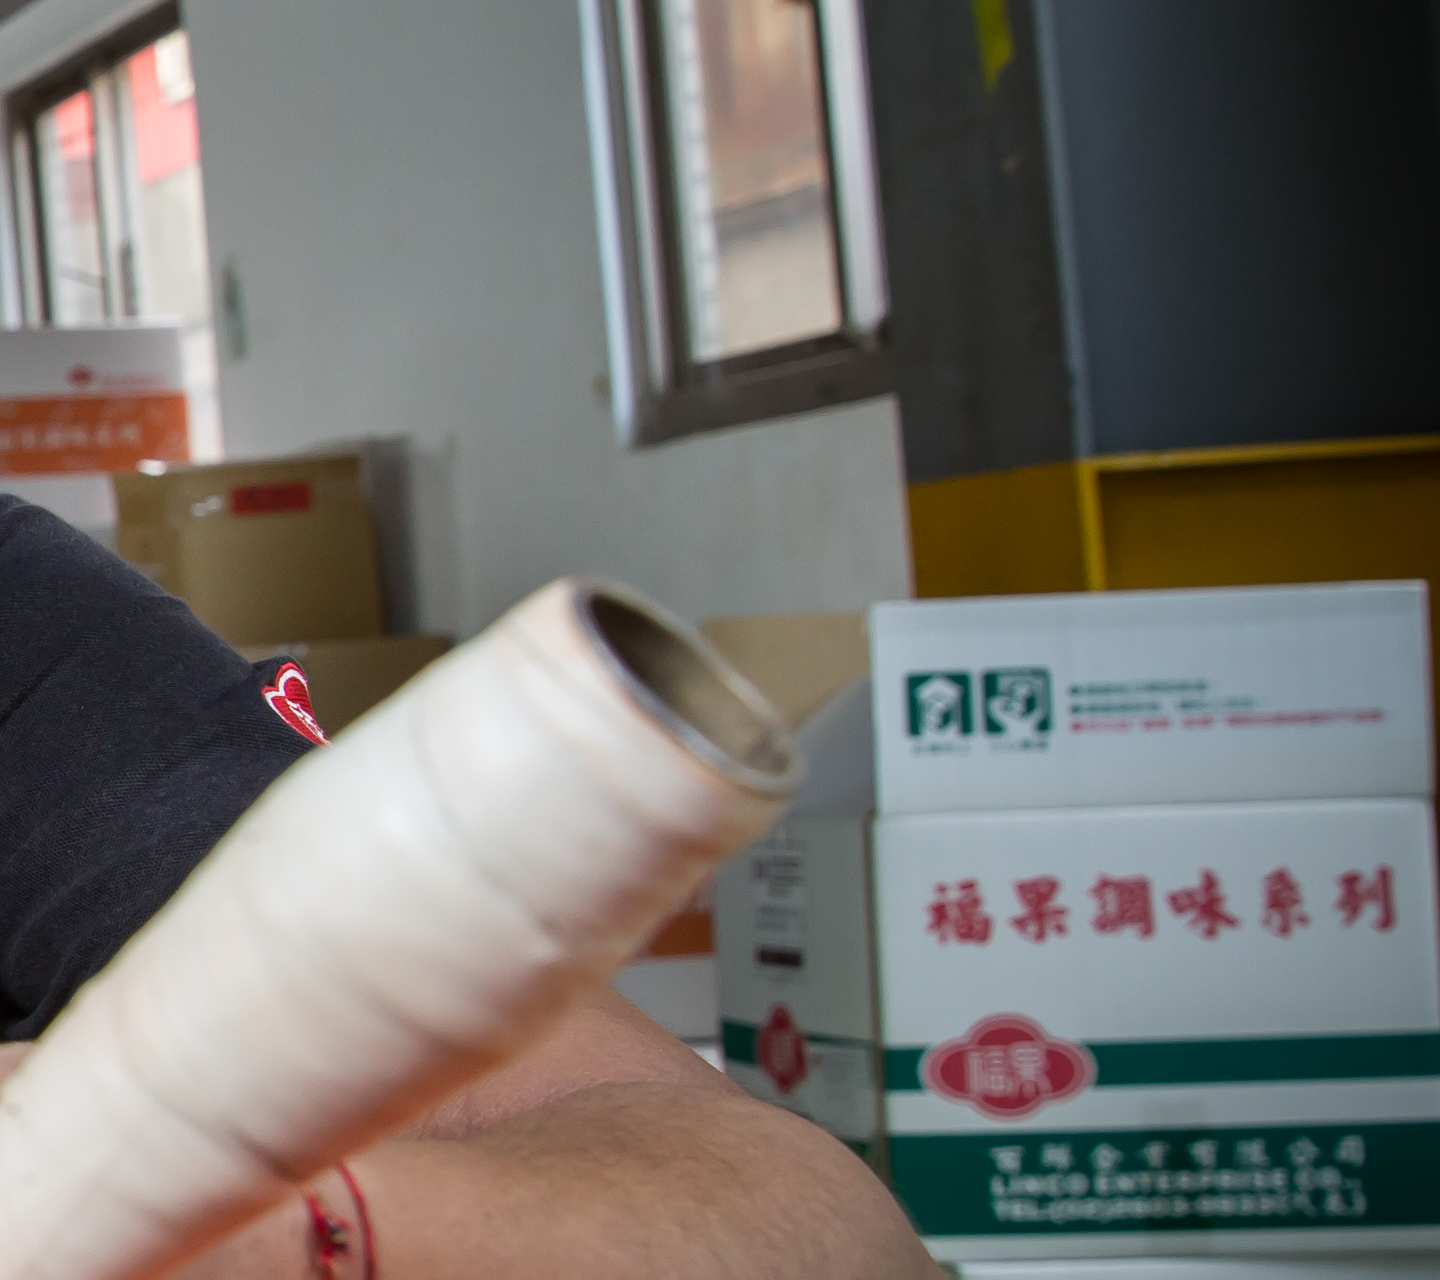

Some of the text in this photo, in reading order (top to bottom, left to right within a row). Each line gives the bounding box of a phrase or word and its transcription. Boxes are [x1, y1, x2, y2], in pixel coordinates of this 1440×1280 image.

[927, 865, 1397, 946] 福果調味系列
